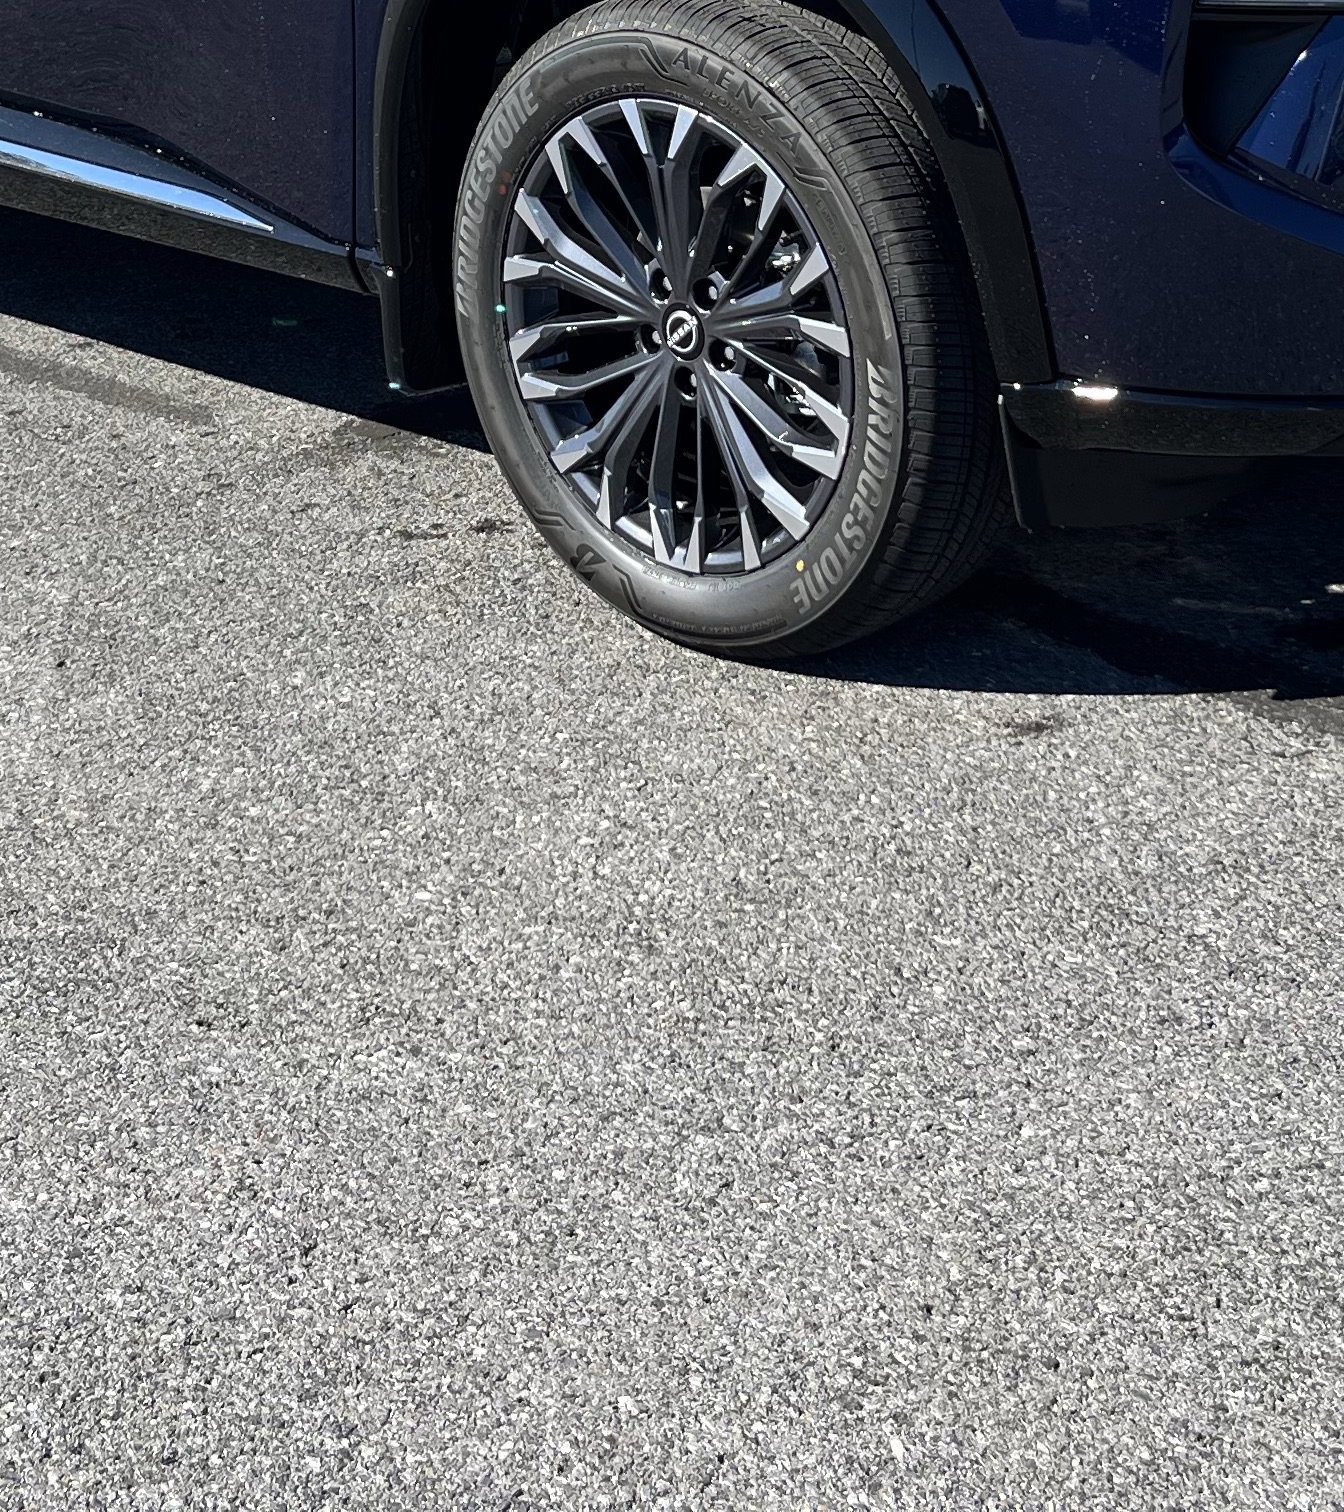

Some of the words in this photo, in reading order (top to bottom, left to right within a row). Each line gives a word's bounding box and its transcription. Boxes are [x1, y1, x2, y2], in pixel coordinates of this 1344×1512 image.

[456, 77, 540, 318] BRIDGESTONE
[671, 47, 802, 160] ALENZA
[789, 357, 898, 615] BRIDGESTONE
